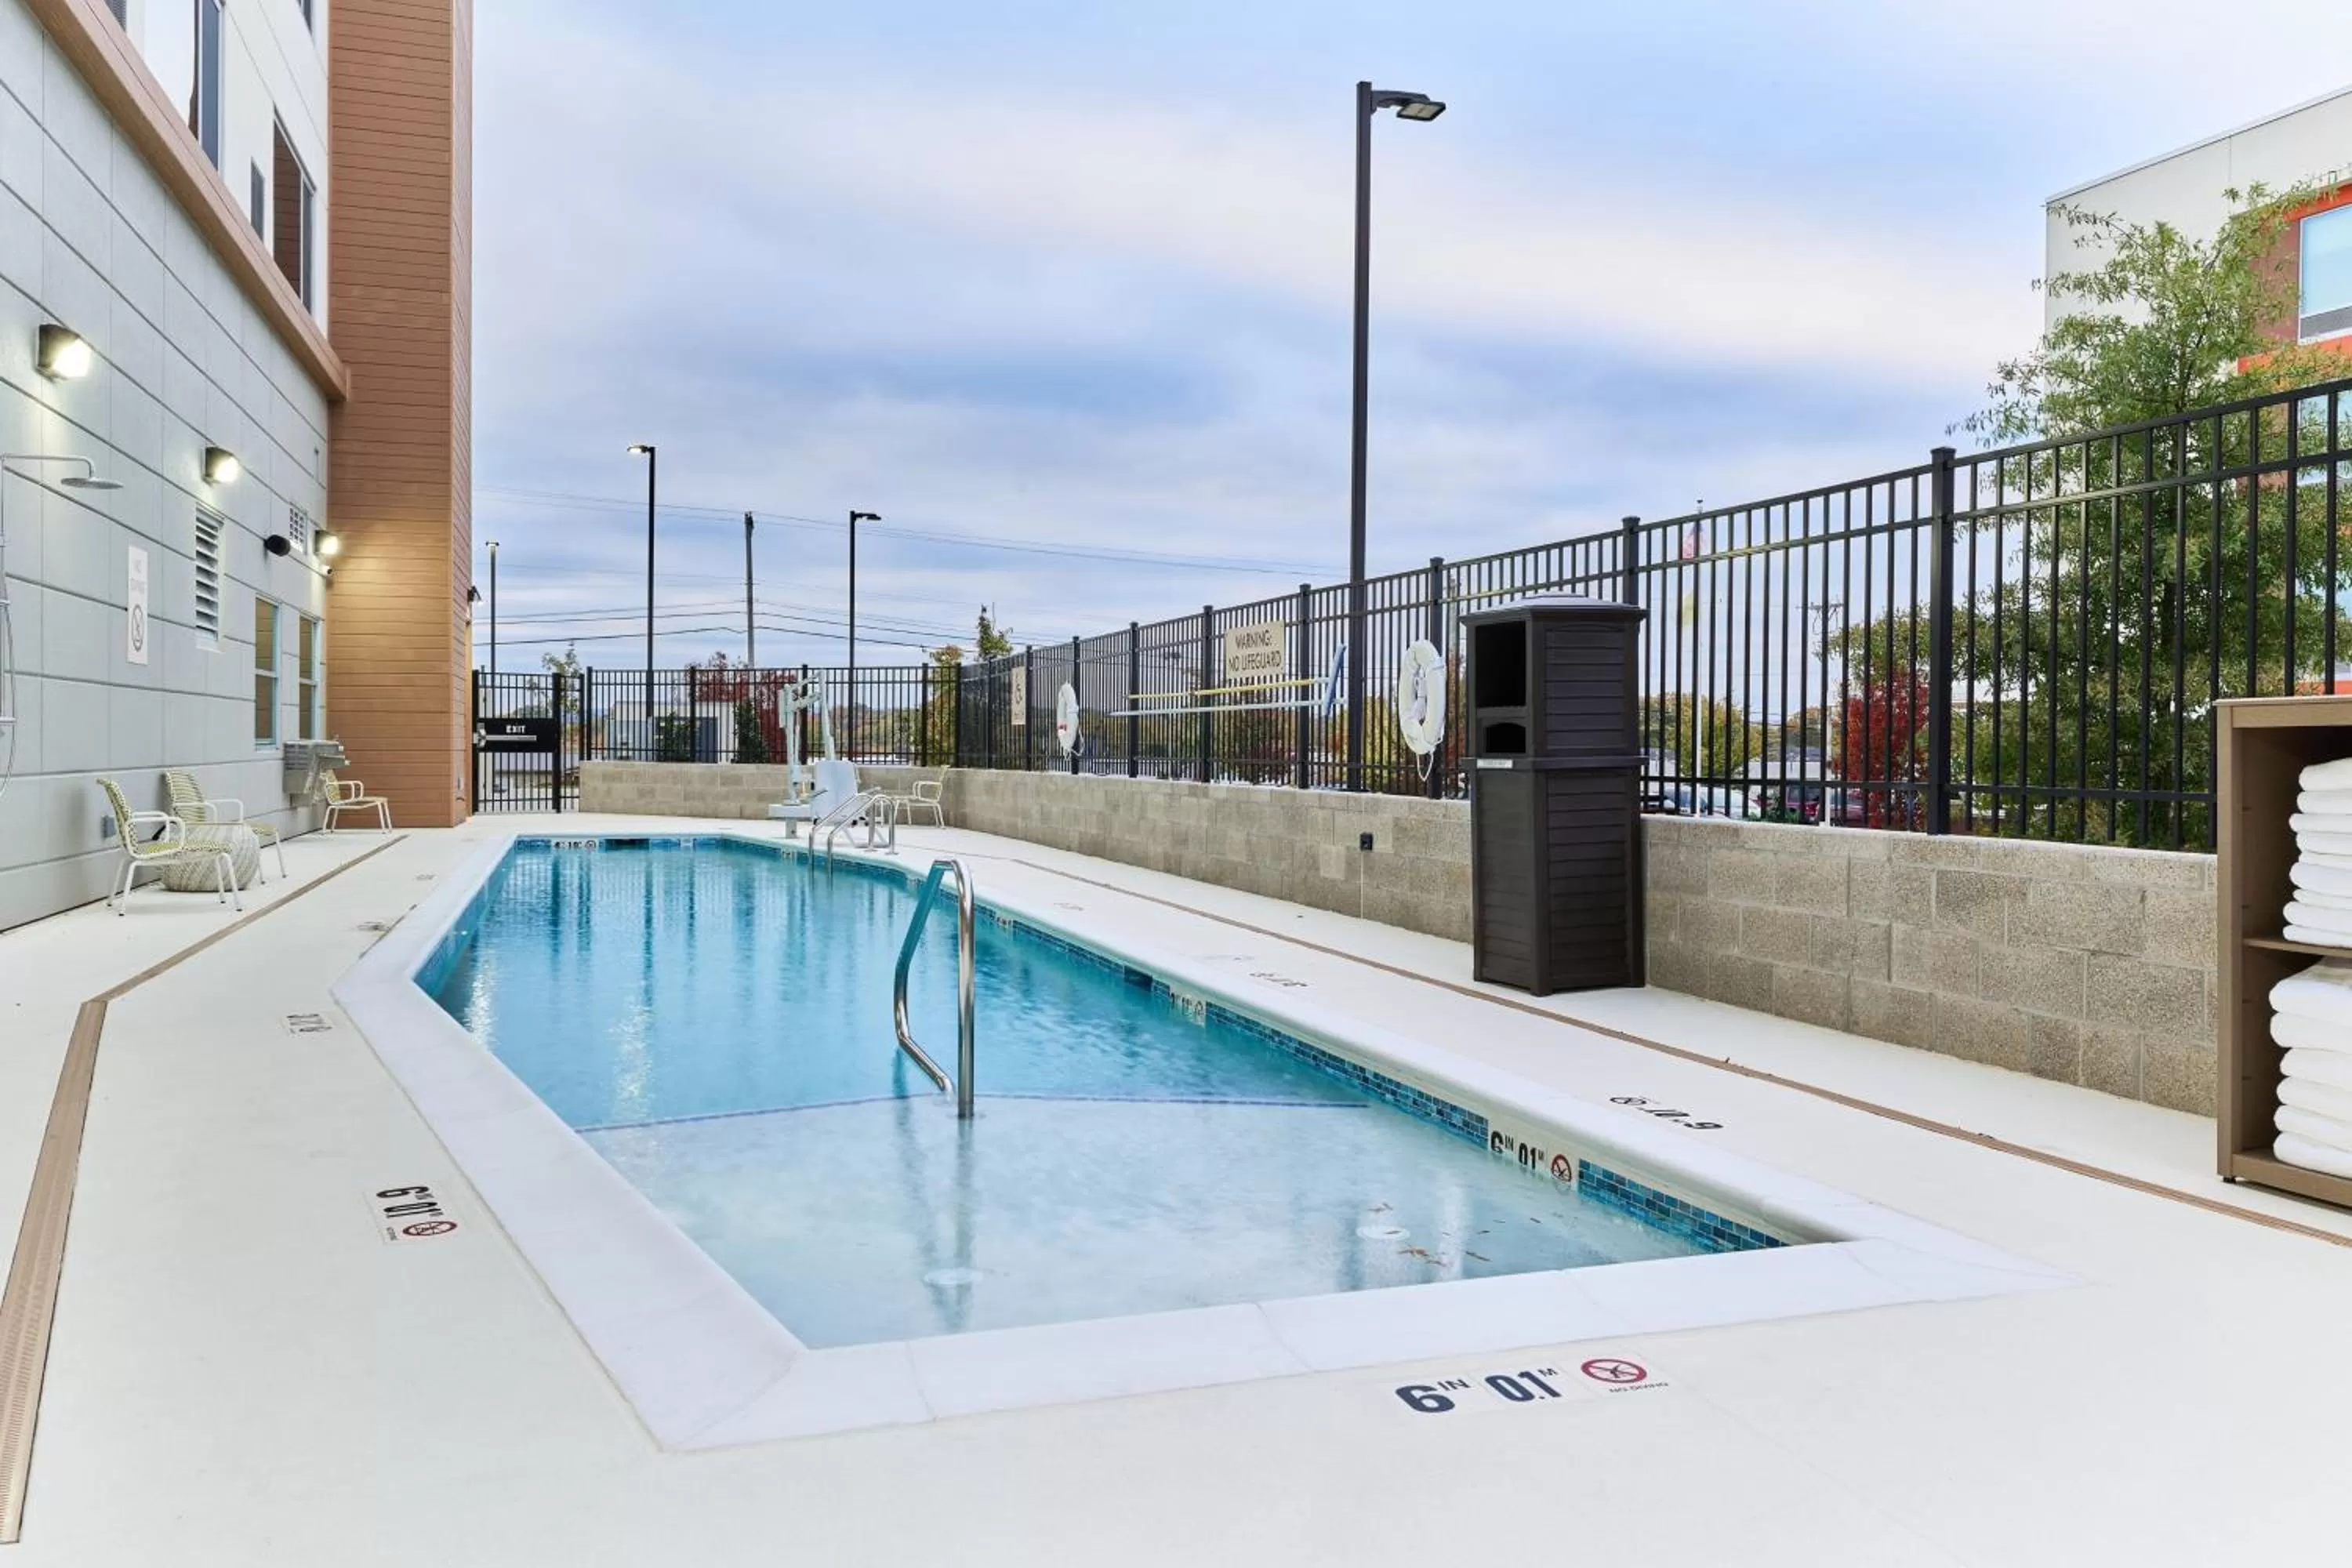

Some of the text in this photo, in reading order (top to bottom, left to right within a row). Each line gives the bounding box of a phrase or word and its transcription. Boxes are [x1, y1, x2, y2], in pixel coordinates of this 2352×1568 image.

[1229, 650, 1282, 672] NO LIFEGUARD
[506, 725, 525, 734] EXIT
